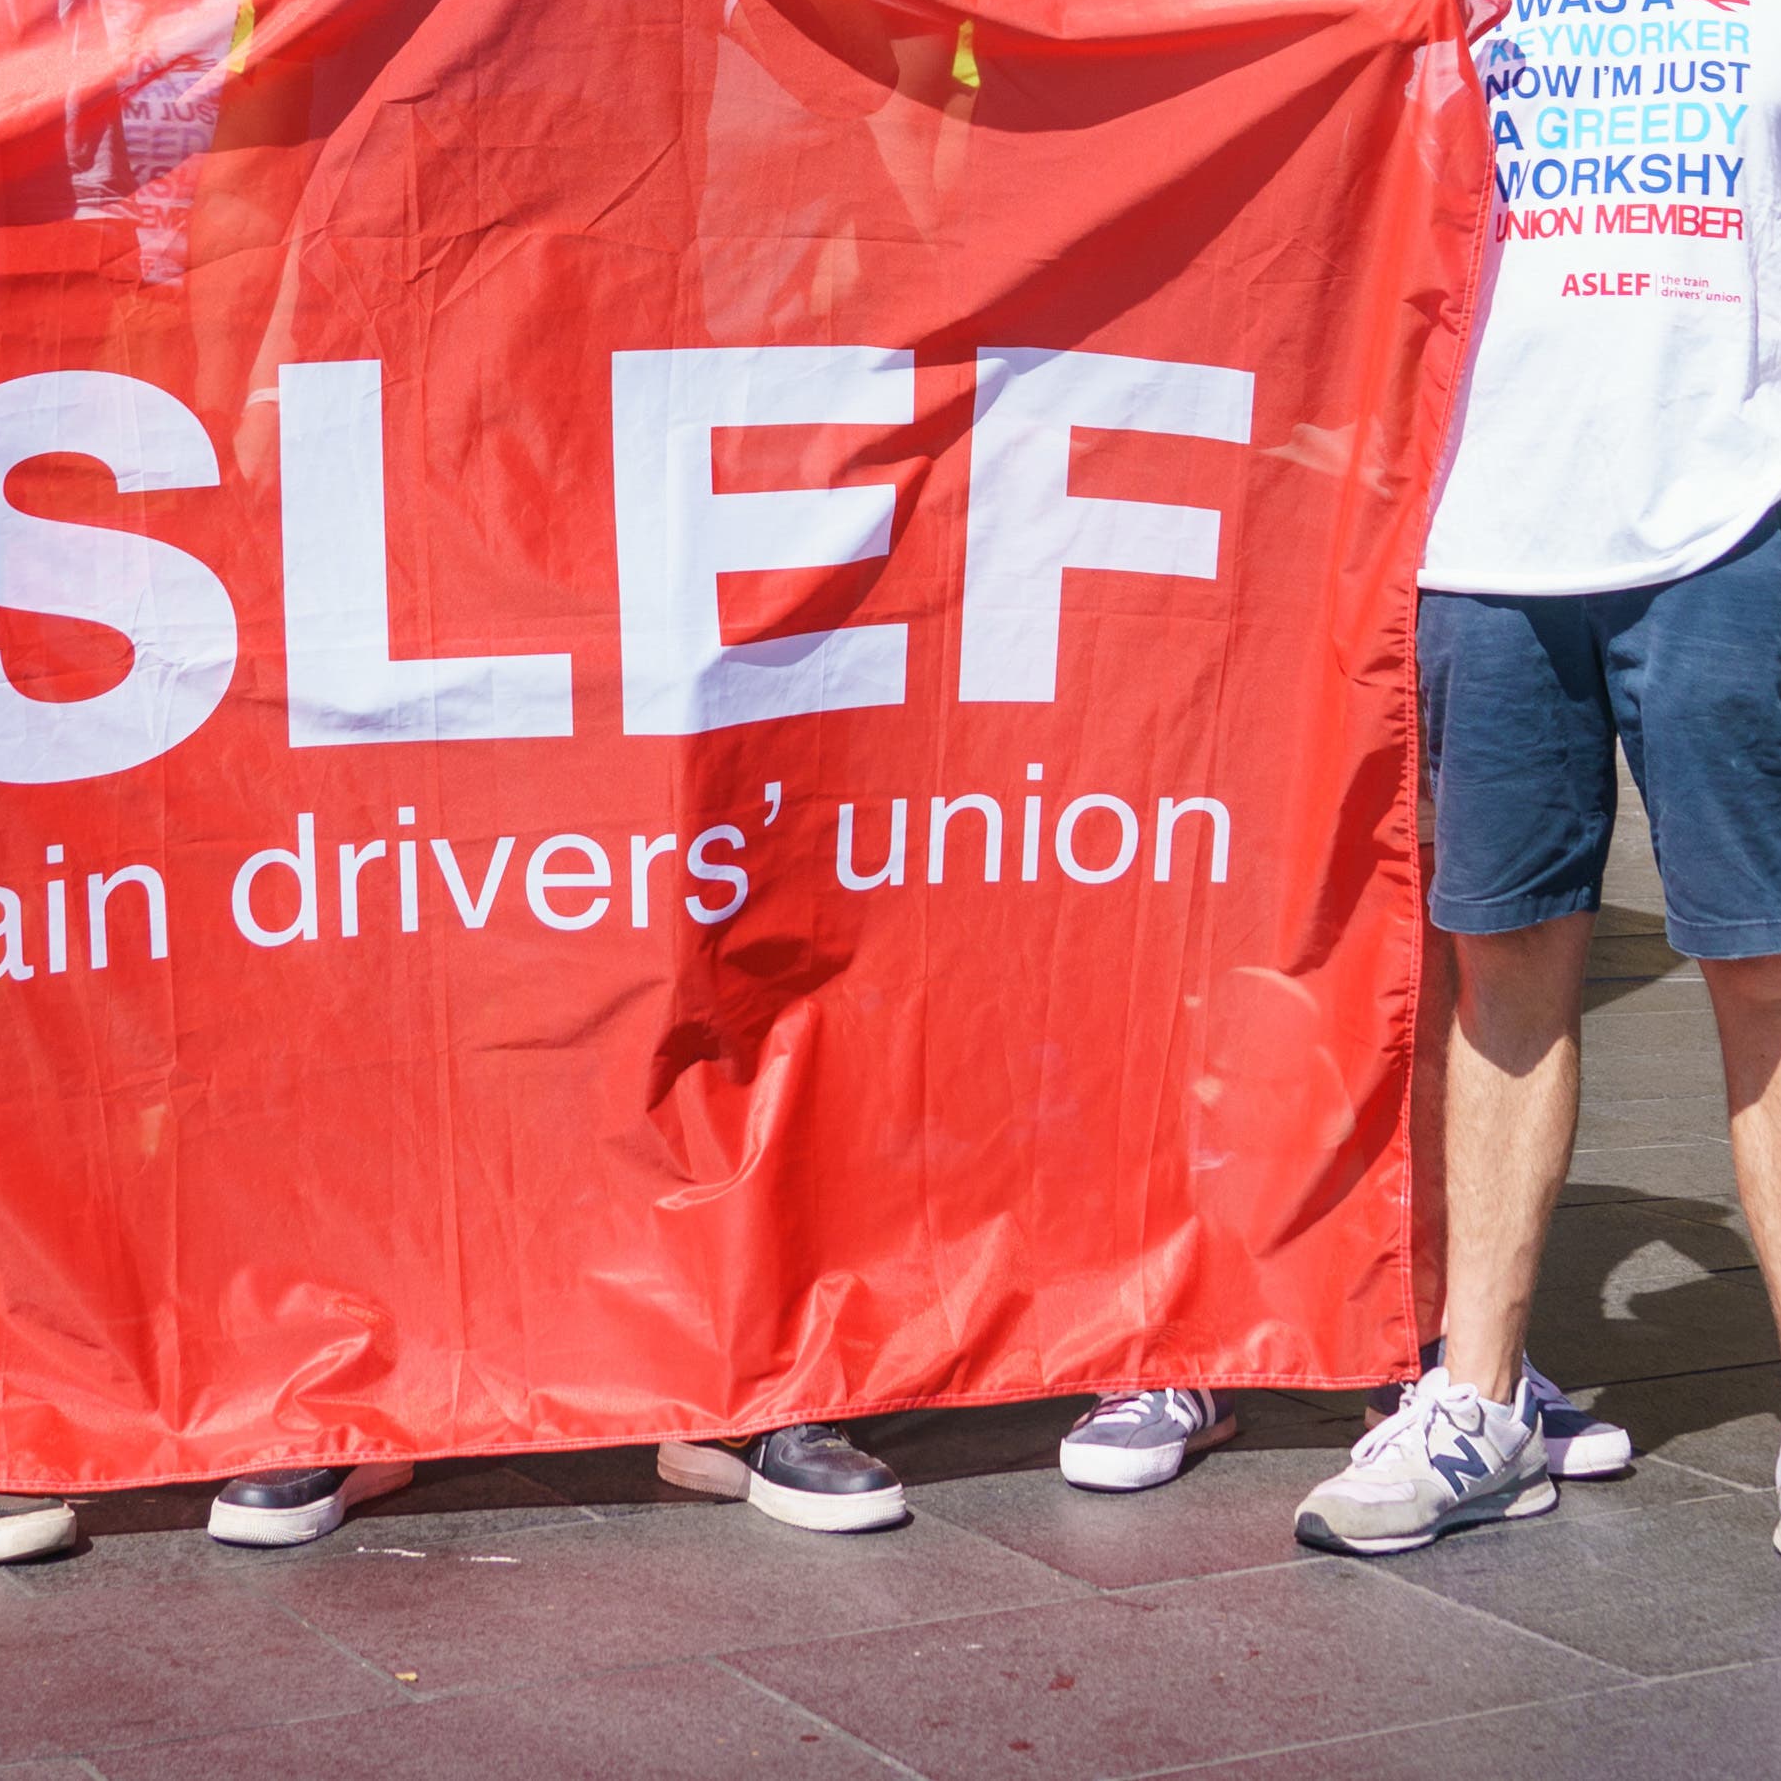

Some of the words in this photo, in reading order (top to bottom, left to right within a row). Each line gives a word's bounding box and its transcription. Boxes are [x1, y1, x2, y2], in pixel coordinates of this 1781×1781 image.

[1489, 19, 1751, 67] KEYWORKER
[1485, 64, 1583, 104] NOW
[1592, 65, 1642, 99] I'M
[1652, 60, 1751, 95] JUST
[1494, 110, 1525, 151] A
[1535, 101, 1750, 150] GREEDY
[1495, 152, 1745, 203] WORKSHY
[1496, 205, 1583, 243] UNION
[1595, 203, 1744, 241] MEMBER
[1561, 271, 1651, 297] ASLEF
[1683, 276, 1710, 288] train
[1706, 292, 1741, 303] union
[231, 781, 784, 948] drivers'
[836, 762, 1232, 892] union
